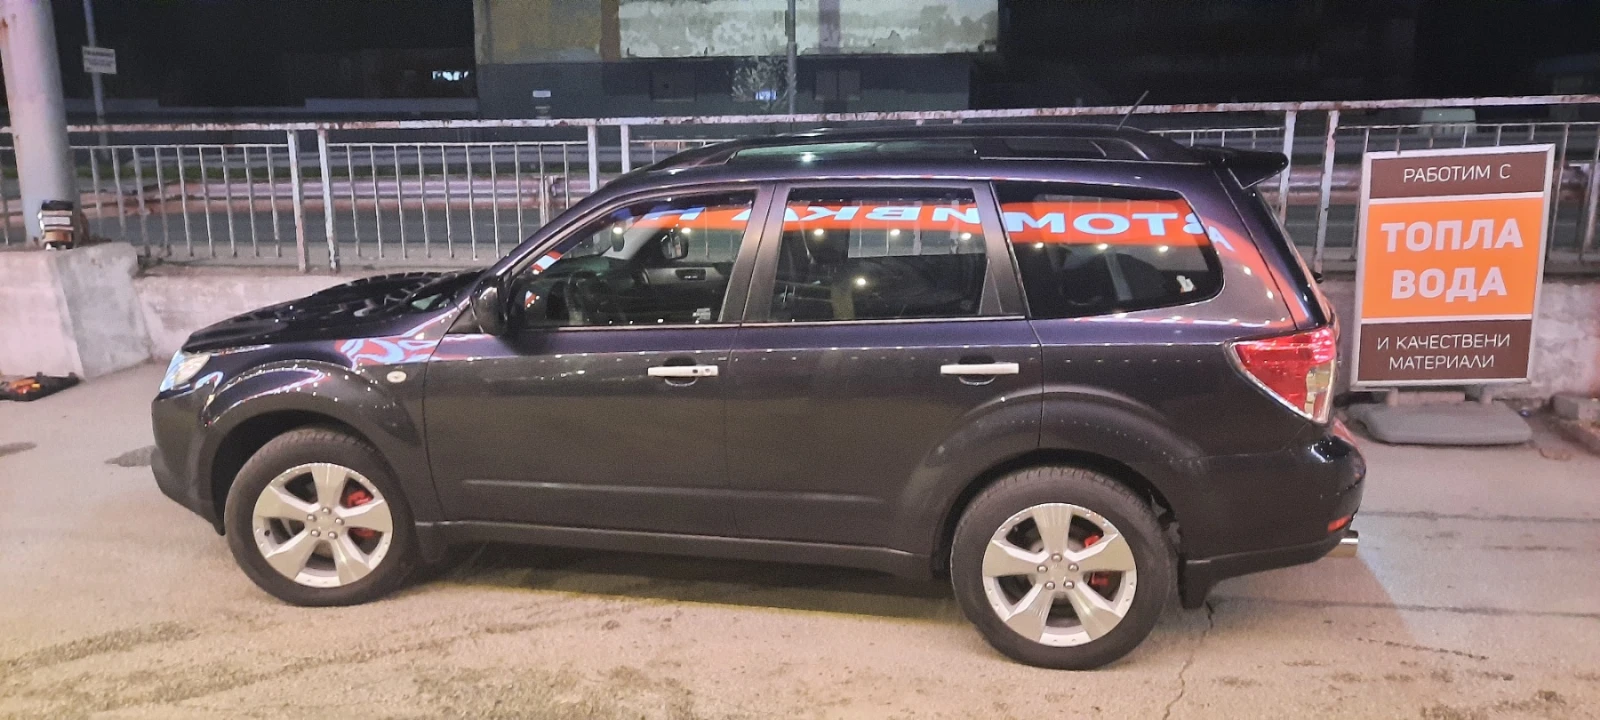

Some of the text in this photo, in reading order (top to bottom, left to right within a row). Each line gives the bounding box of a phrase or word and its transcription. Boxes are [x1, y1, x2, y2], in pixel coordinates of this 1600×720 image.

[1403, 163, 1512, 183] РАБОТИМ С
[1380, 218, 1524, 253] ТОПЛА
[1391, 267, 1508, 303] ВОДА
[1377, 333, 1511, 350] И КАЧЕСТВЕНИ
[1389, 354, 1495, 370] МАТЕРИАЛИ
